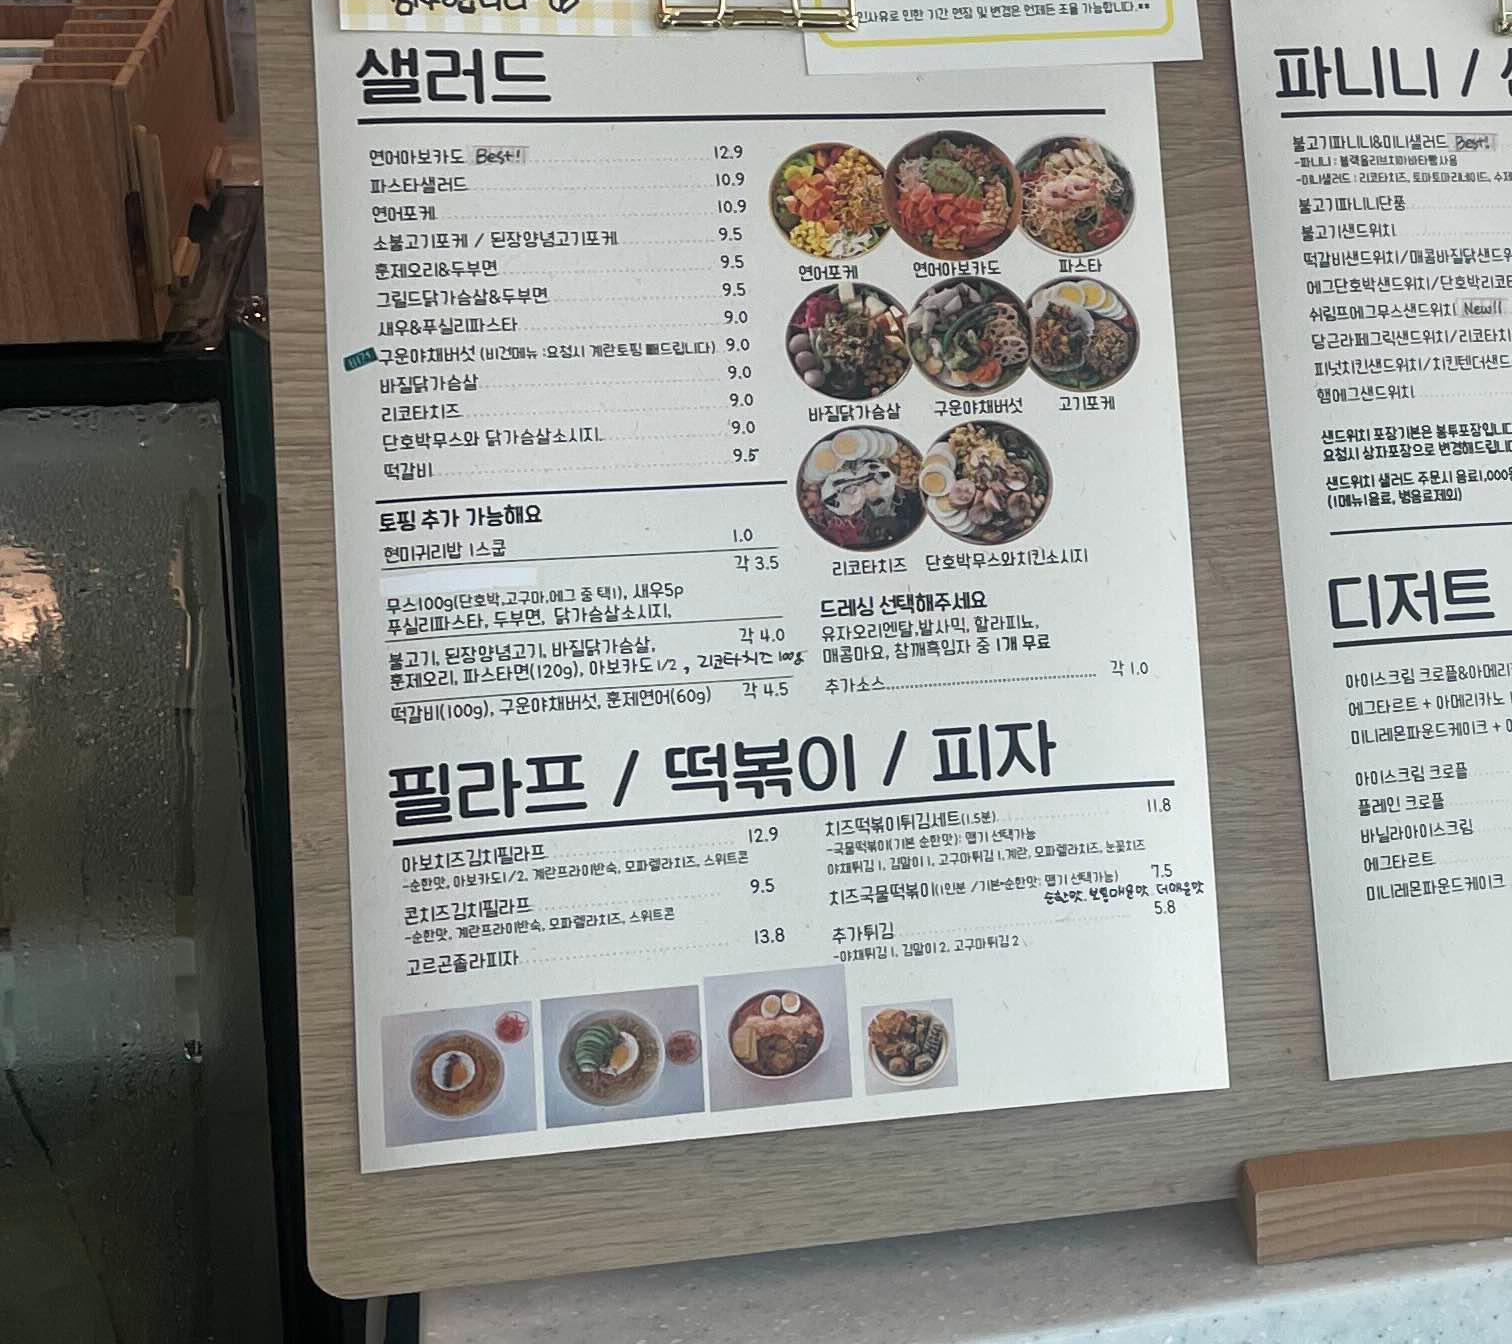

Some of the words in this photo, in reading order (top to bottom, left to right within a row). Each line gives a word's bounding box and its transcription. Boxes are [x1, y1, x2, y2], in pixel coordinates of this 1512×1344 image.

[356, 47, 552, 105] 샐러드
[1274, 45, 1439, 99] 파니니
[370, 148, 465, 166] 연어아보카도
[475, 147, 521, 164] Best!
[714, 145, 743, 160] 12.9
[1293, 133, 1447, 151] 불고기파니니&미니샐러드
[371, 176, 468, 194] 파스타샐러드
[715, 172, 745, 187] 10.9
[372, 205, 437, 222] 연어포케
[717, 199, 747, 214] 10.9
[373, 233, 468, 251] 소불고기포케
[490, 229, 618, 248] 된장양념고기포케
[718, 227, 743, 242] 9.5
[1302, 223, 1397, 241] 불고기샌드위치
[375, 259, 498, 280] 훈제오리&두부면
[720, 255, 745, 270] 9.5
[799, 264, 858, 281] 연어포케
[913, 261, 1002, 278] 연어아보카도
[1059, 258, 1102, 272] 파스타
[377, 287, 548, 308] 그릴드닭가슴살&두부면
[722, 282, 746, 298] 9.5
[380, 374, 479, 394] 바질닭가슴살
[727, 365, 752, 380] 9.0
[381, 404, 463, 422] 리코타치즈
[729, 393, 754, 408] 9.0
[1317, 385, 1415, 405] 햄에그샌드위치
[809, 403, 901, 423] 바질닭가슴살
[934, 398, 1023, 417] 구운야채버섯
[1059, 396, 1115, 412] 고기포케
[384, 461, 434, 480] 떡갈비
[733, 448, 759, 463] 9.5
[379, 510, 416, 533] 토핑
[421, 508, 459, 530] 추가
[466, 505, 542, 527] 가능해요
[383, 542, 463, 564] 현미귀리밥
[469, 539, 506, 559] 1스쿱
[732, 528, 753, 543] 1.0
[832, 557, 907, 577] 리코타치즈
[926, 548, 1089, 572] 단호박무스와치킨소시지
[821, 596, 875, 618] 드레싱
[879, 590, 987, 614] 선택해주세요
[1328, 567, 1496, 630] 디저트
[825, 676, 886, 694] 추가소스
[1110, 660, 1125, 676] 각
[1130, 661, 1149, 675] 1.0
[388, 753, 588, 828] 필라프
[665, 733, 856, 803] 떡볶이
[932, 719, 1057, 783] 피자
[1355, 762, 1425, 787] 아이스크림
[1429, 761, 1468, 781] 크로플
[1358, 797, 1401, 817] 플레인
[1405, 792, 1445, 811] 크로플
[1361, 818, 1474, 844] 바닐라아이스크림
[1364, 851, 1436, 872] 에그타르트
[1367, 873, 1506, 902] 미니레몬파운드케이크
[832, 923, 895, 945] 추가튀김
[1154, 900, 1176, 915] 5.8
[406, 950, 519, 977] 고르곤졸라피자
[754, 928, 785, 944] 13.8
